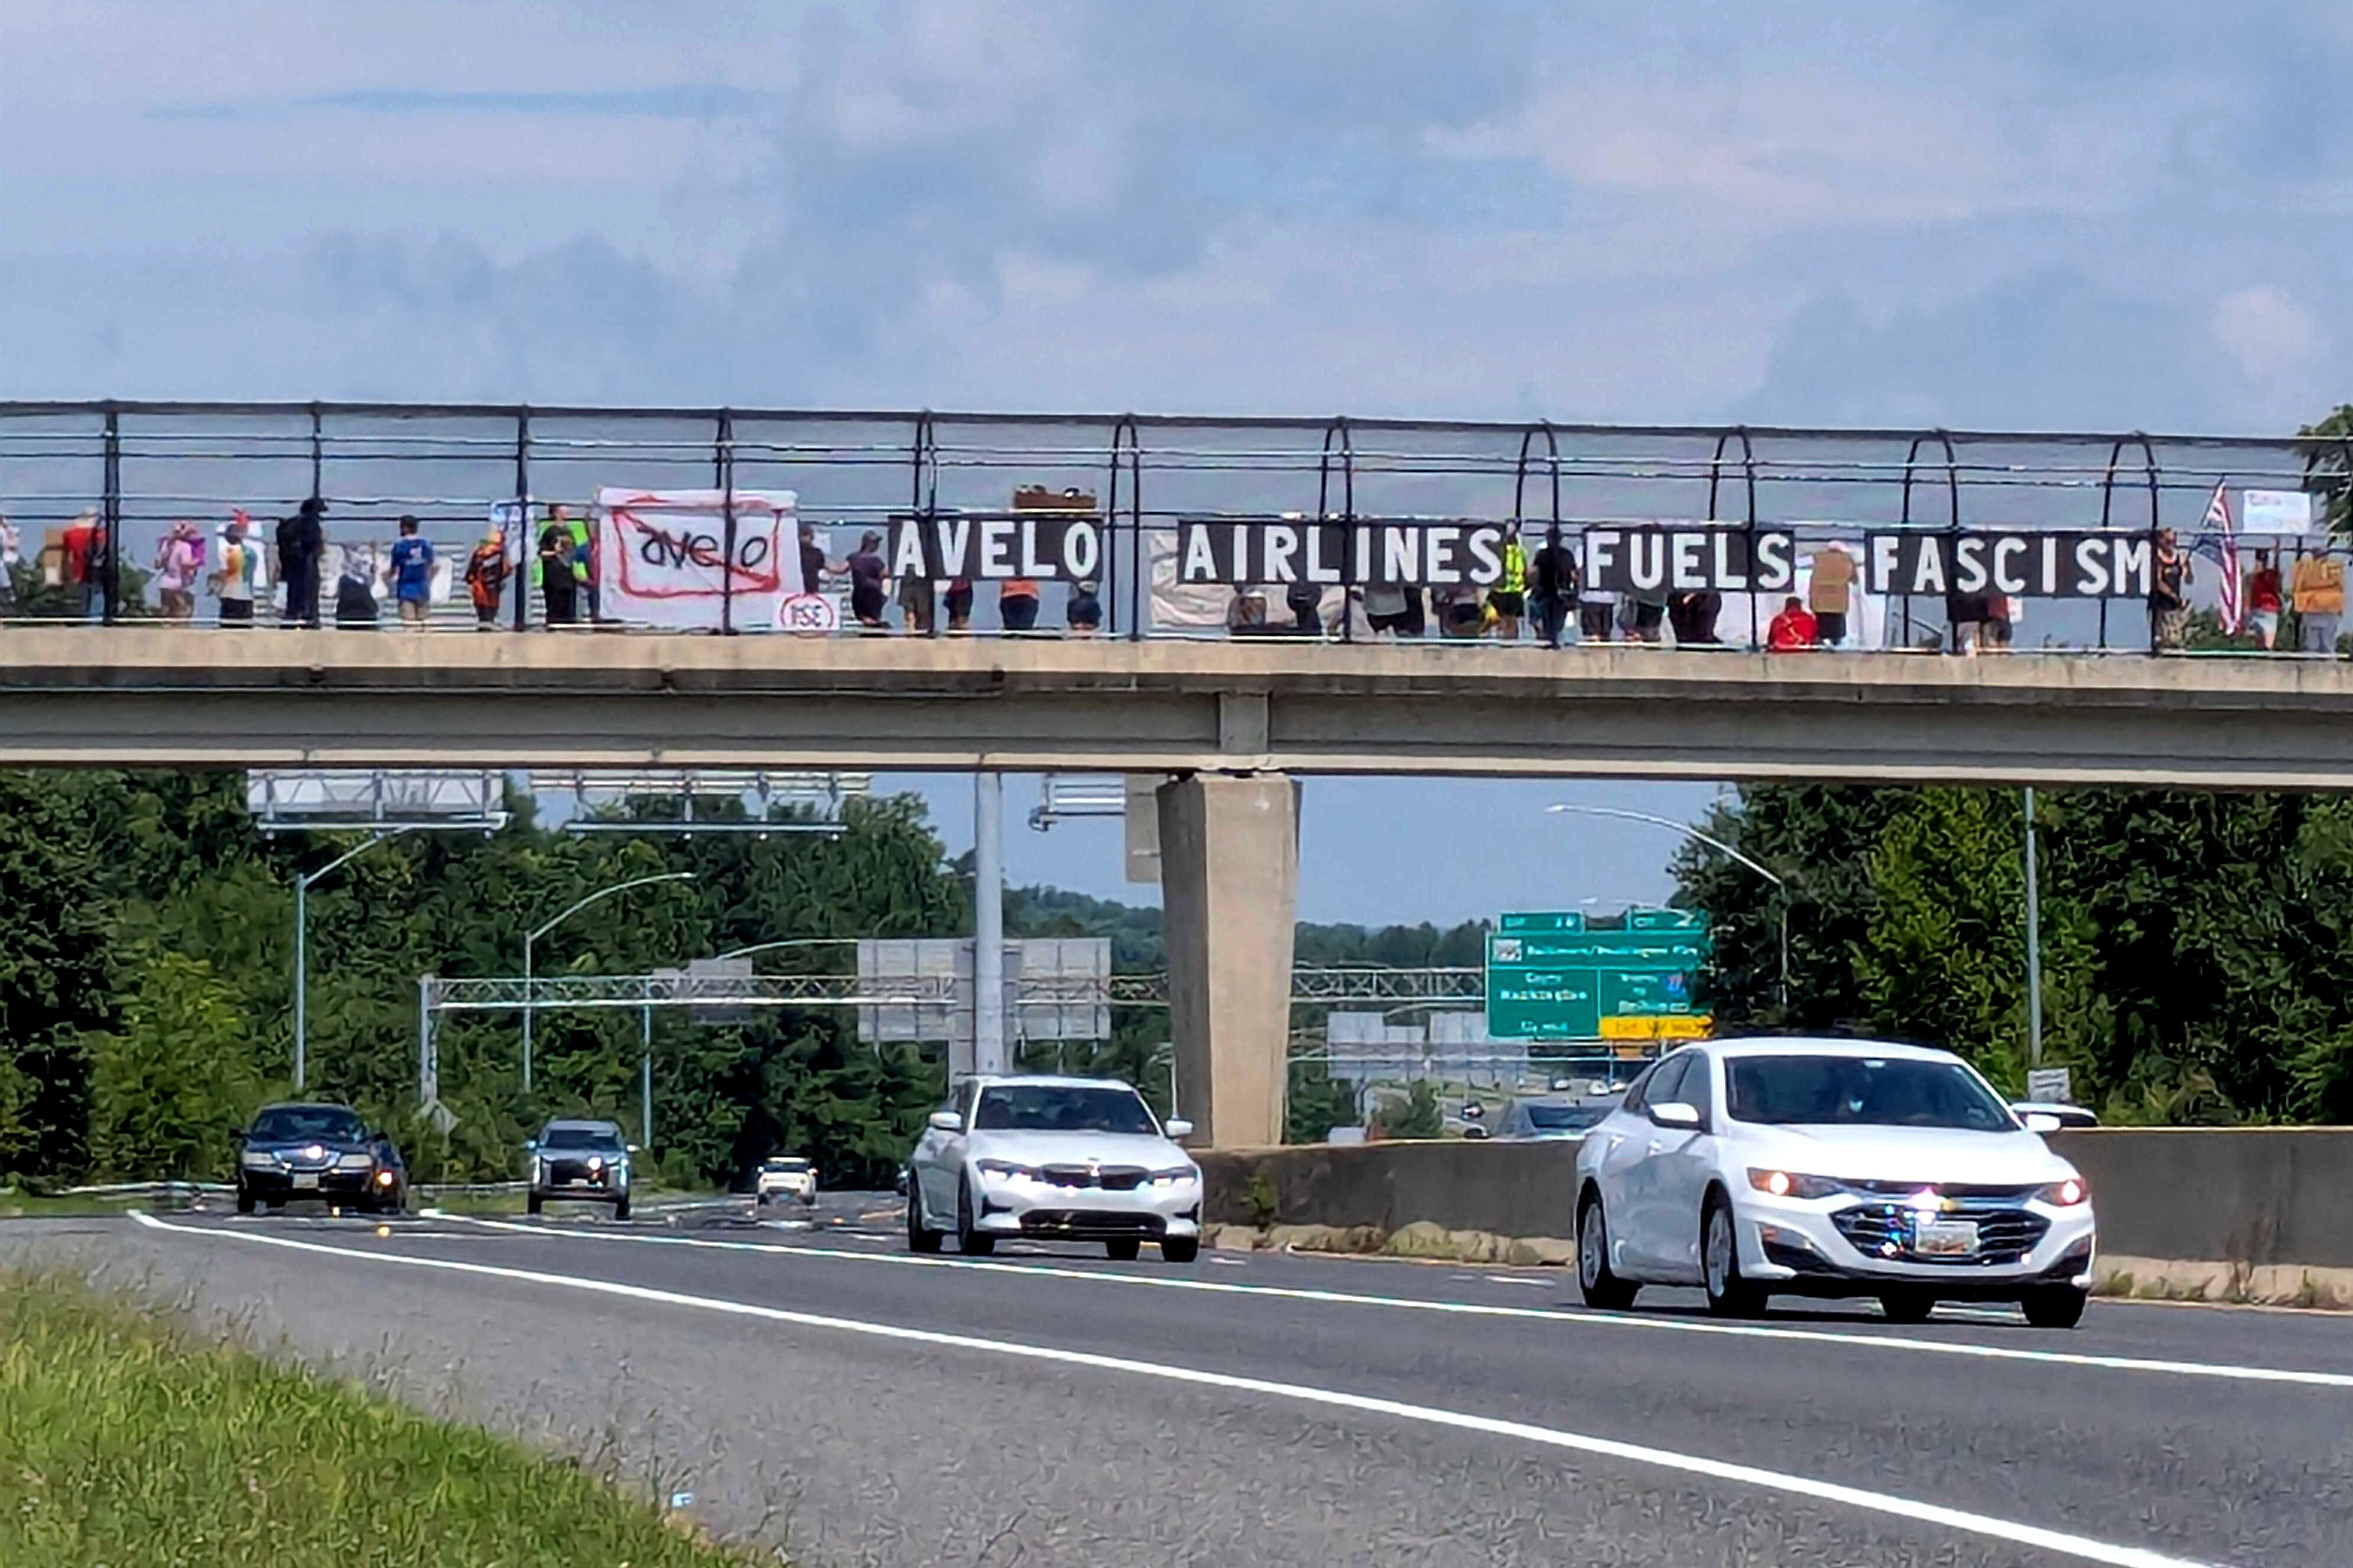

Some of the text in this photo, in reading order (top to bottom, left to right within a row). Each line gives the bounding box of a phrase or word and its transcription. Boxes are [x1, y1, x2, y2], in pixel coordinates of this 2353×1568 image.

[895, 521, 1098, 577] AVELO
[1184, 525, 1504, 583] AIRLINES
[1587, 532, 1790, 589] FUELS
[1873, 536, 2151, 594] FASCISM
